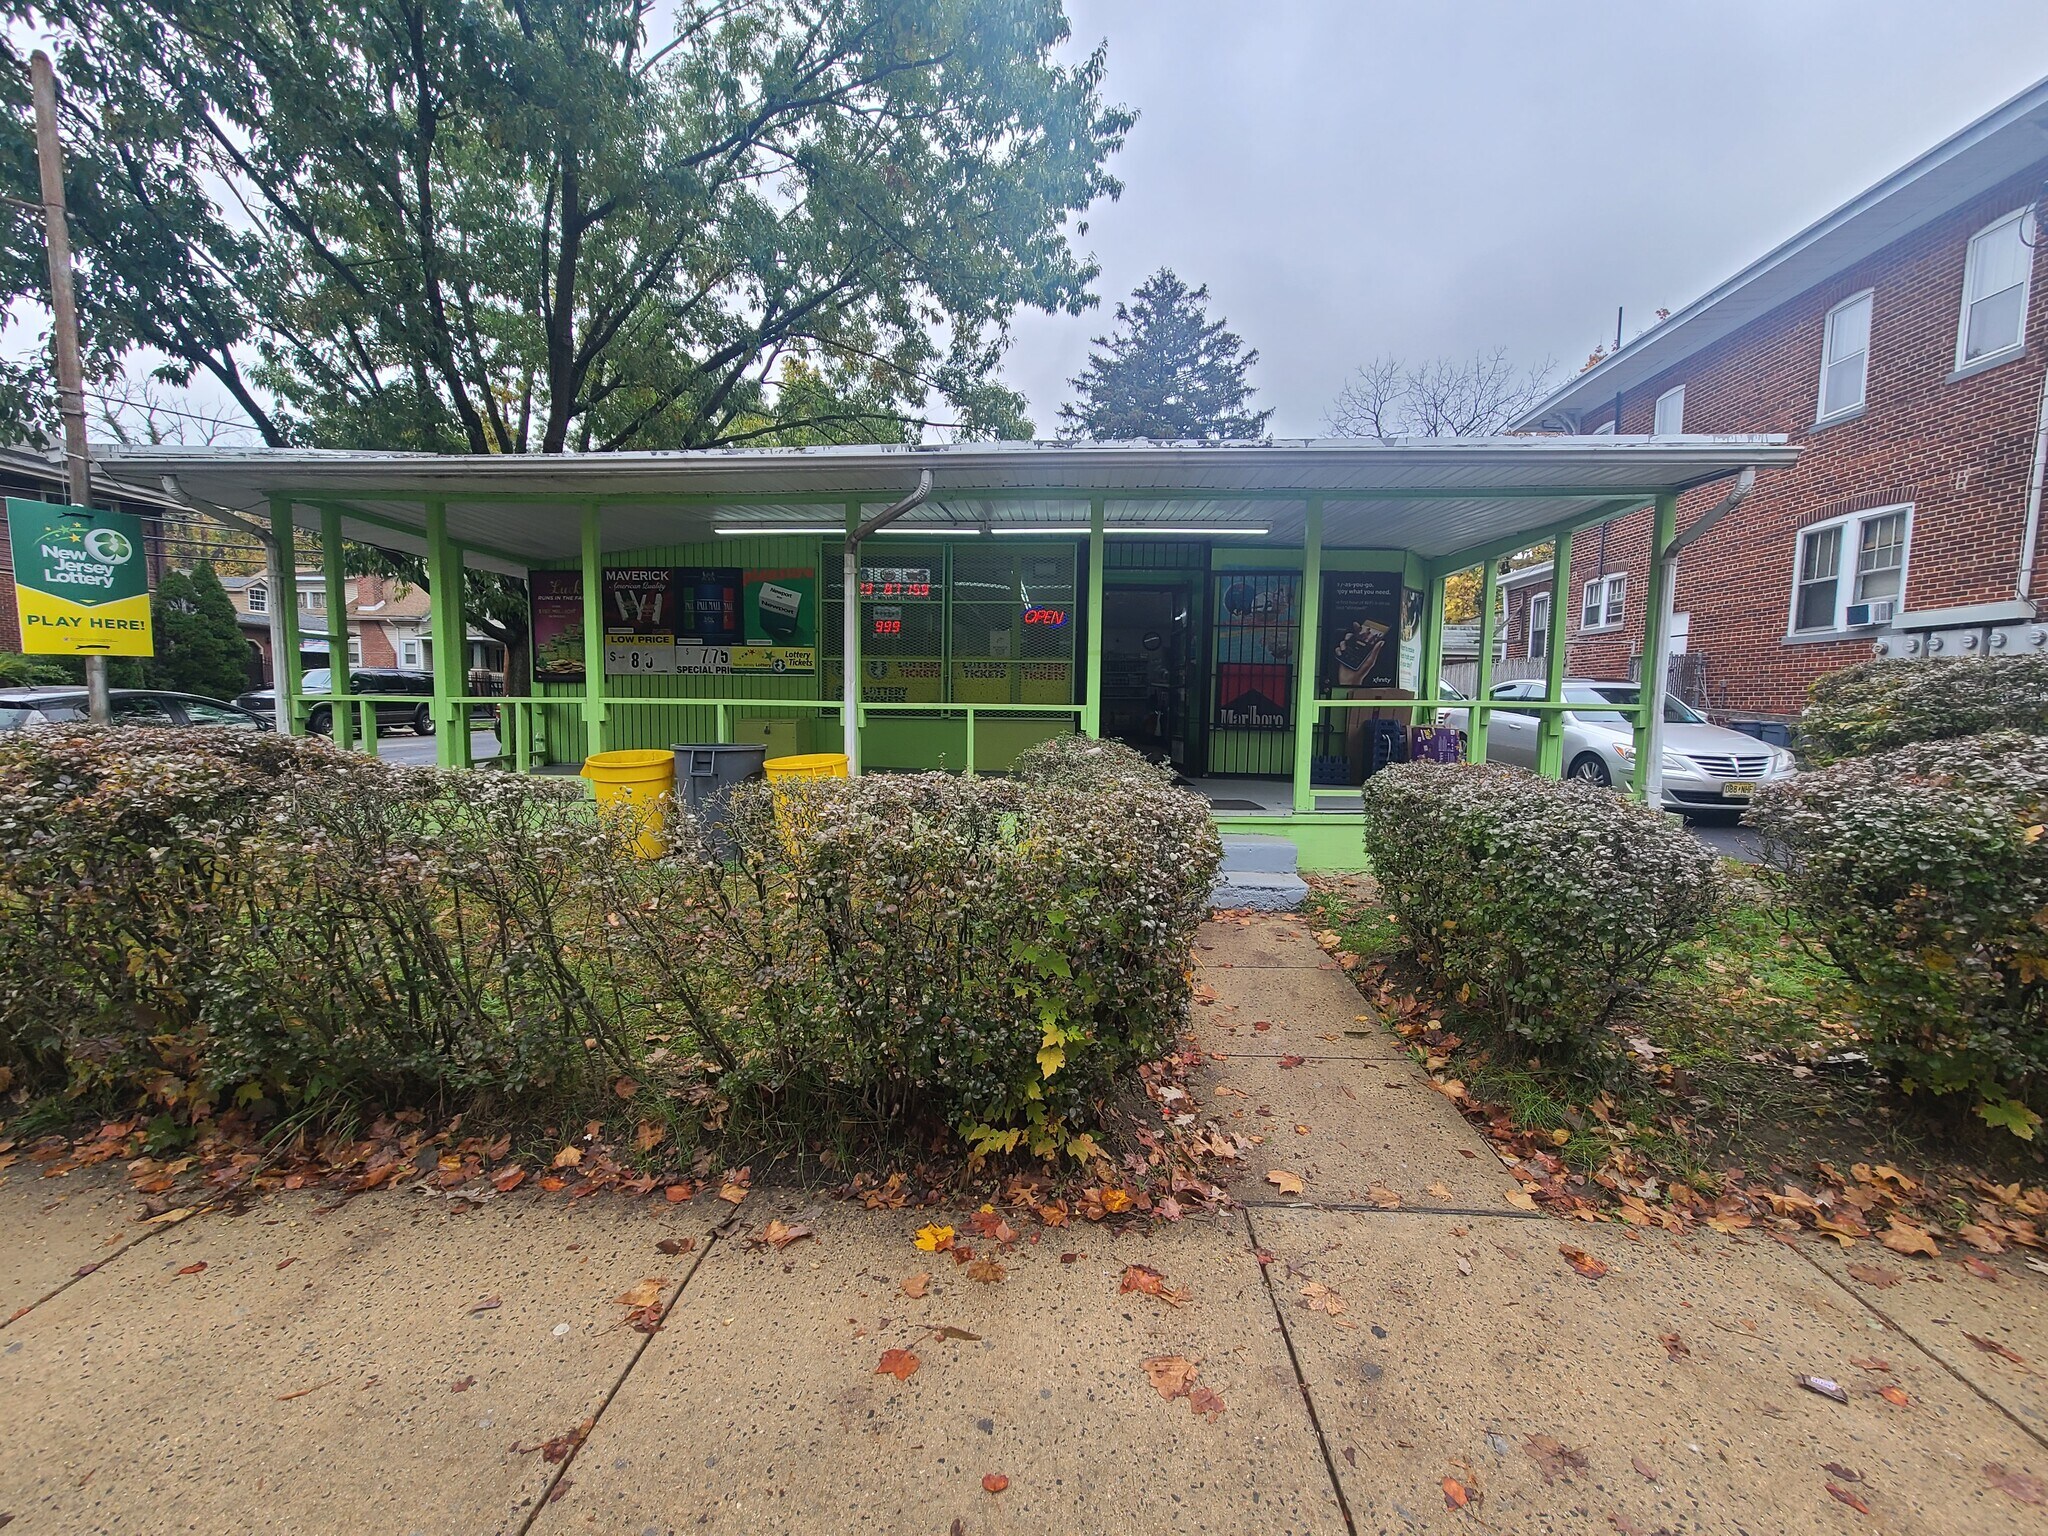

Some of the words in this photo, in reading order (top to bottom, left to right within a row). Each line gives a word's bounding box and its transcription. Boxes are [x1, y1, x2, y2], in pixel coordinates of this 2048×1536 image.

[42, 544, 87, 561] New
[54, 558, 114, 577] Jersey
[44, 568, 114, 588] Lottery
[606, 571, 669, 580] MAVERICK
[609, 582, 640, 590] American
[642, 582, 666, 591] Quality
[770, 588, 793, 599] Newport
[761, 600, 794, 614] Newport
[27, 615, 82, 627] PLAY
[90, 618, 145, 630] HERE!
[1025, 610, 1064, 624] OPEN
[875, 620, 901, 633] 999
[701, 648, 729, 664] 7.75
[785, 650, 811, 660] Lottery
[789, 658, 813, 667] Tickets
[676, 666, 713, 674] SPECIAL
[715, 666, 731, 674] PRI
[964, 669, 1007, 679] TICKETS
[1023, 671, 1066, 680] TICKETS
[1372, 676, 1391, 684] xfinity
[862, 686, 908, 696] LOTTERY
[1220, 705, 1284, 728] Marlboro
